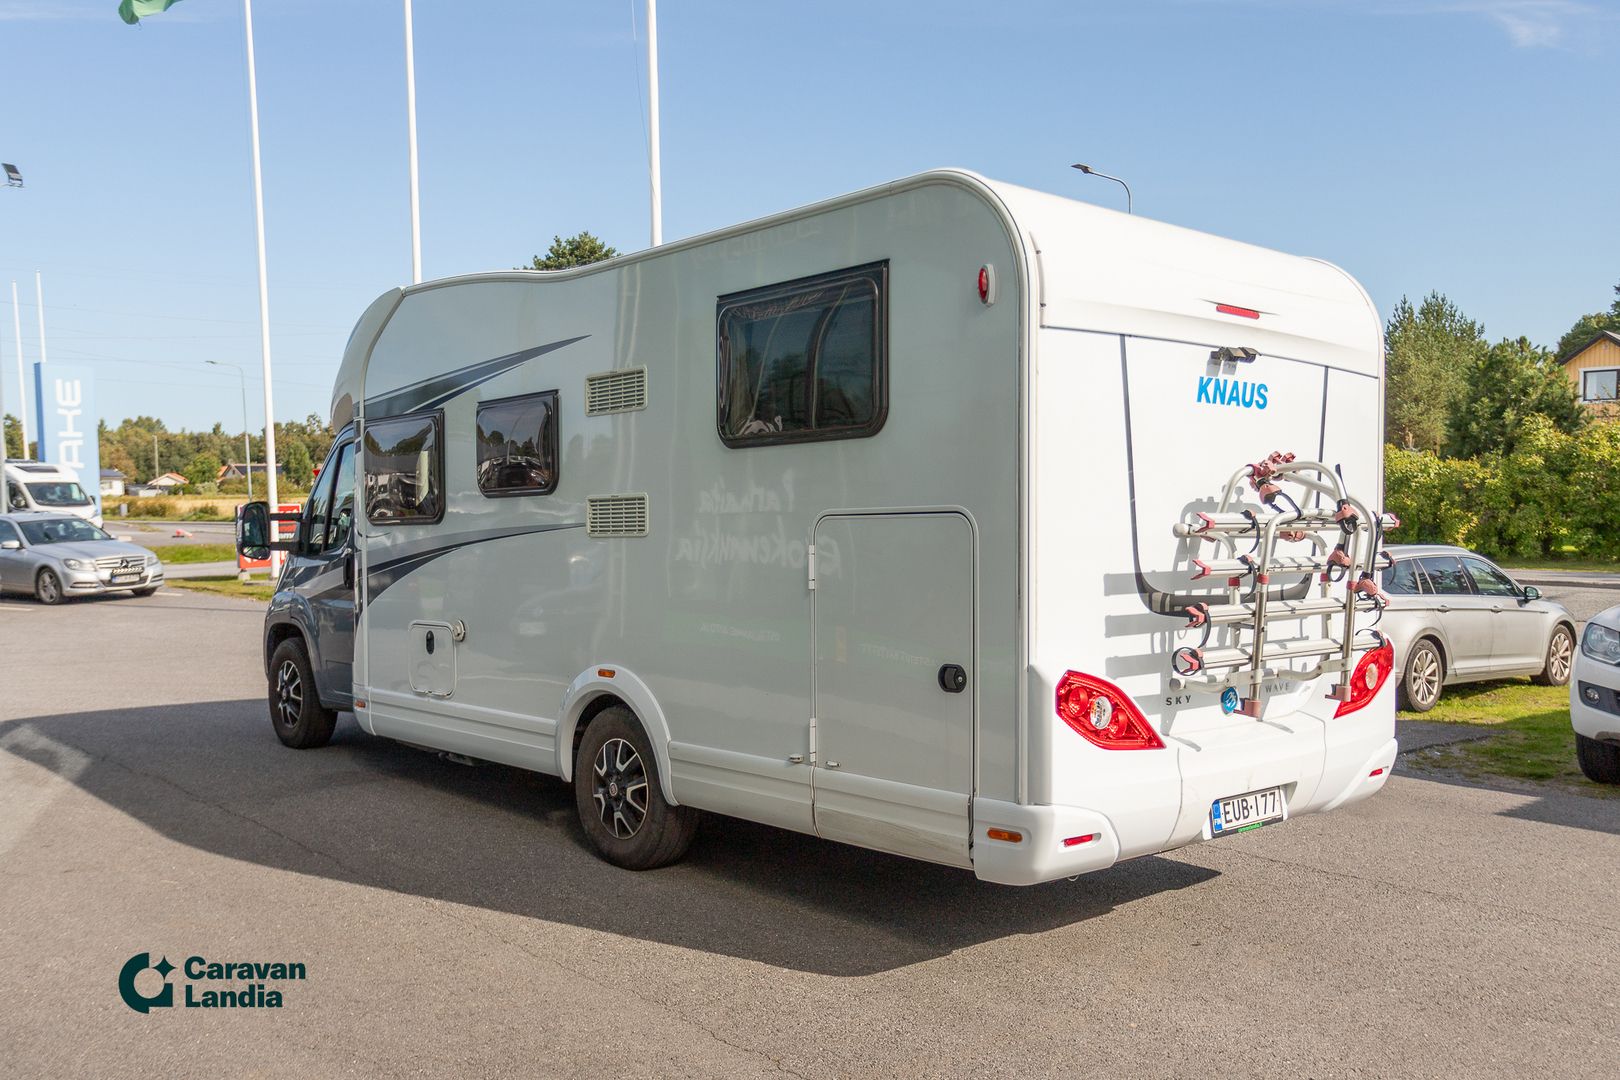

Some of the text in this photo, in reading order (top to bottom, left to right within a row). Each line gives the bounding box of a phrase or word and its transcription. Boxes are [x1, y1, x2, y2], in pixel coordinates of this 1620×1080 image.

[1196, 376, 1268, 410] KNAUS
[1165, 682, 1290, 706] SKY WAVE
[1222, 791, 1276, 824] EUB-177
